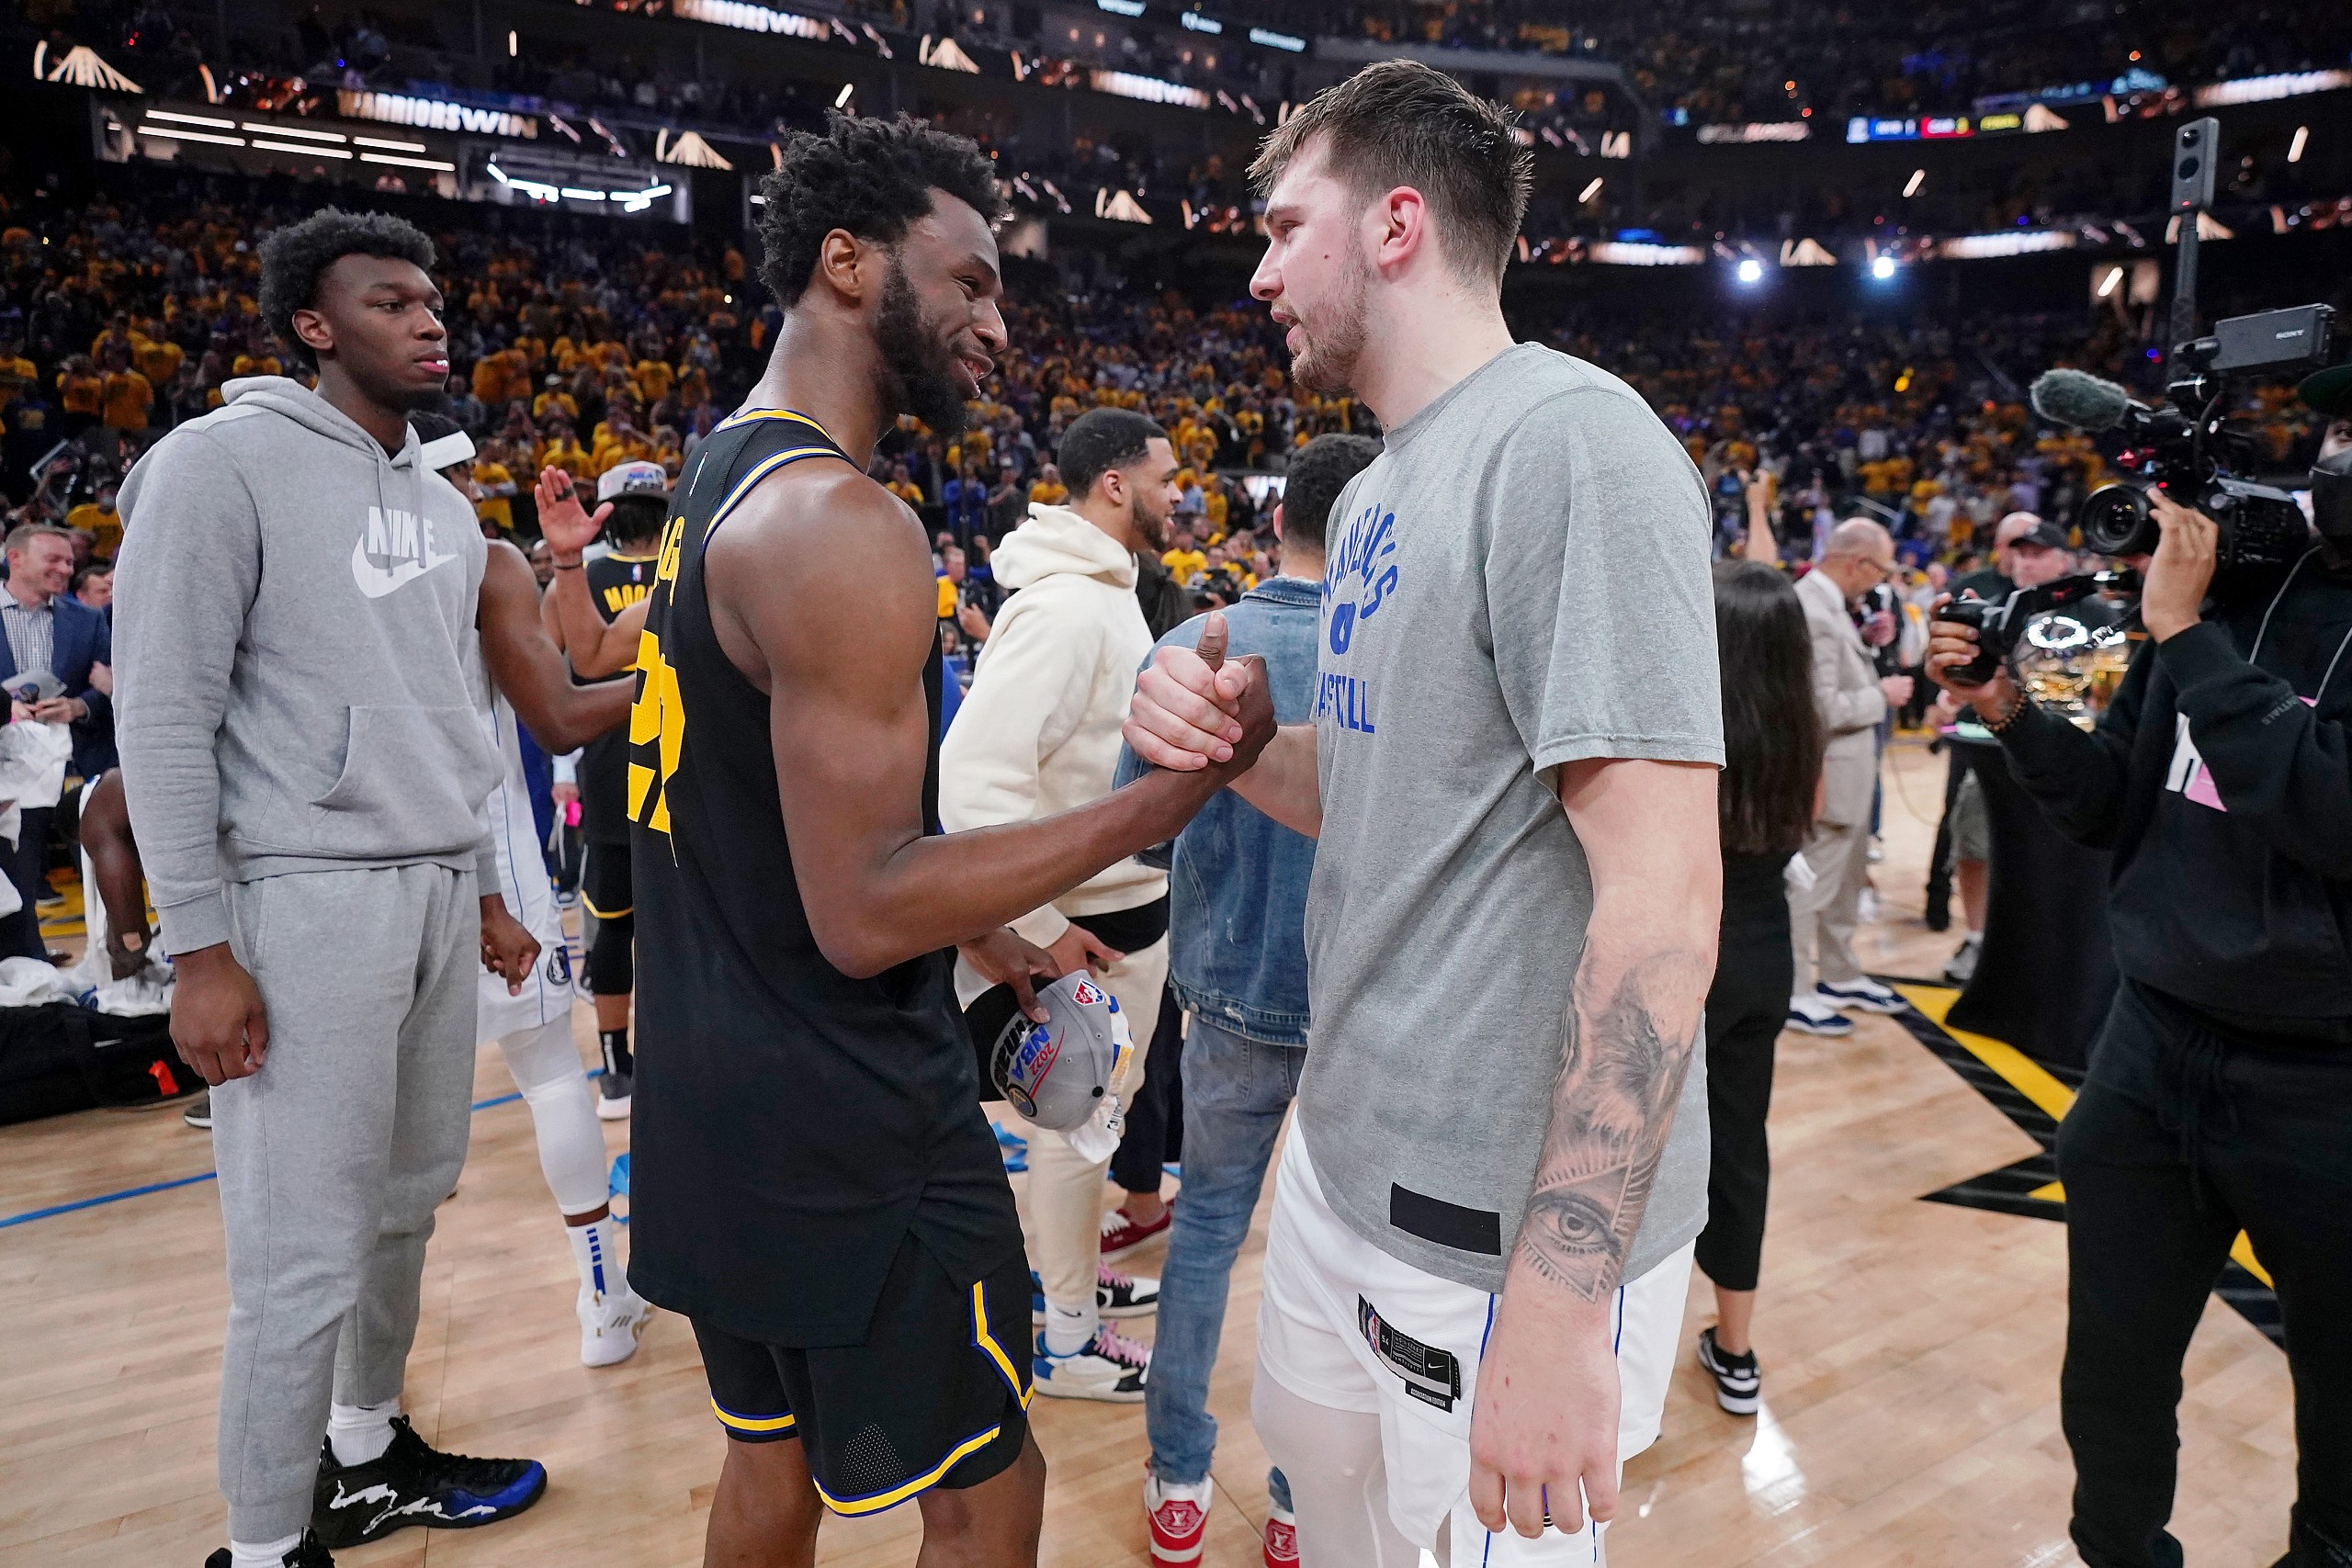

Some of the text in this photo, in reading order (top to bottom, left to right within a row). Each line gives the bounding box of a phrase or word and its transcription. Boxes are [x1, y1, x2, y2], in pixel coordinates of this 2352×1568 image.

[368, 505, 438, 558] NIKE
[603, 583, 654, 614] MOO
[1012, 1024, 1050, 1082] NBA
[1029, 1042, 1055, 1076] 2022
